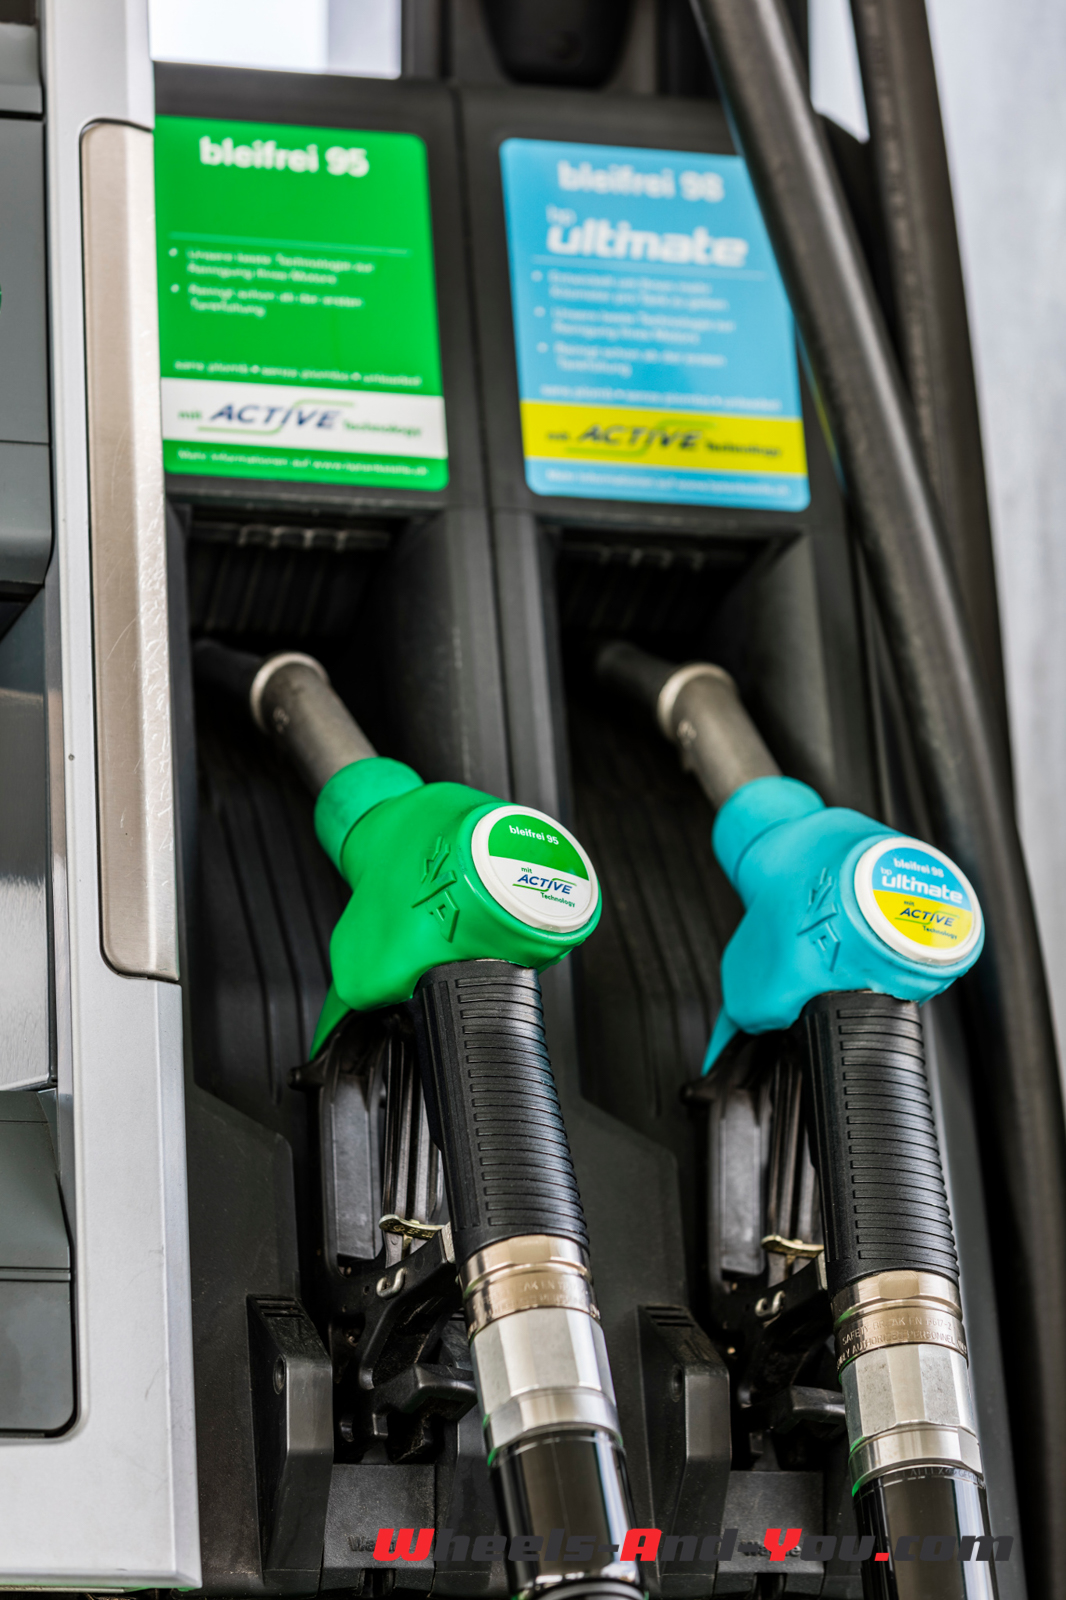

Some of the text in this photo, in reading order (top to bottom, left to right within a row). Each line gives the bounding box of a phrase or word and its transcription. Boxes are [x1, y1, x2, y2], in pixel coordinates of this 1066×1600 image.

[199, 135, 370, 178] bleifrei 95
[557, 160, 725, 203] bleifrei 98
[546, 217, 749, 268] ultimate
[210, 402, 343, 430] ACTIVE
[578, 424, 705, 449] ACTIVE
[509, 825, 559, 845] bleifrei 95
[880, 867, 893, 877] bp
[893, 858, 945, 878] bleifrei 98
[517, 874, 573, 895] ACTIVE
[882, 873, 963, 904] ultimate
[540, 892, 576, 908] Technology
[900, 908, 956, 927] ACTIVE
[922, 925, 958, 940] Technology
[842, 1325, 869, 1346] SAFETY
